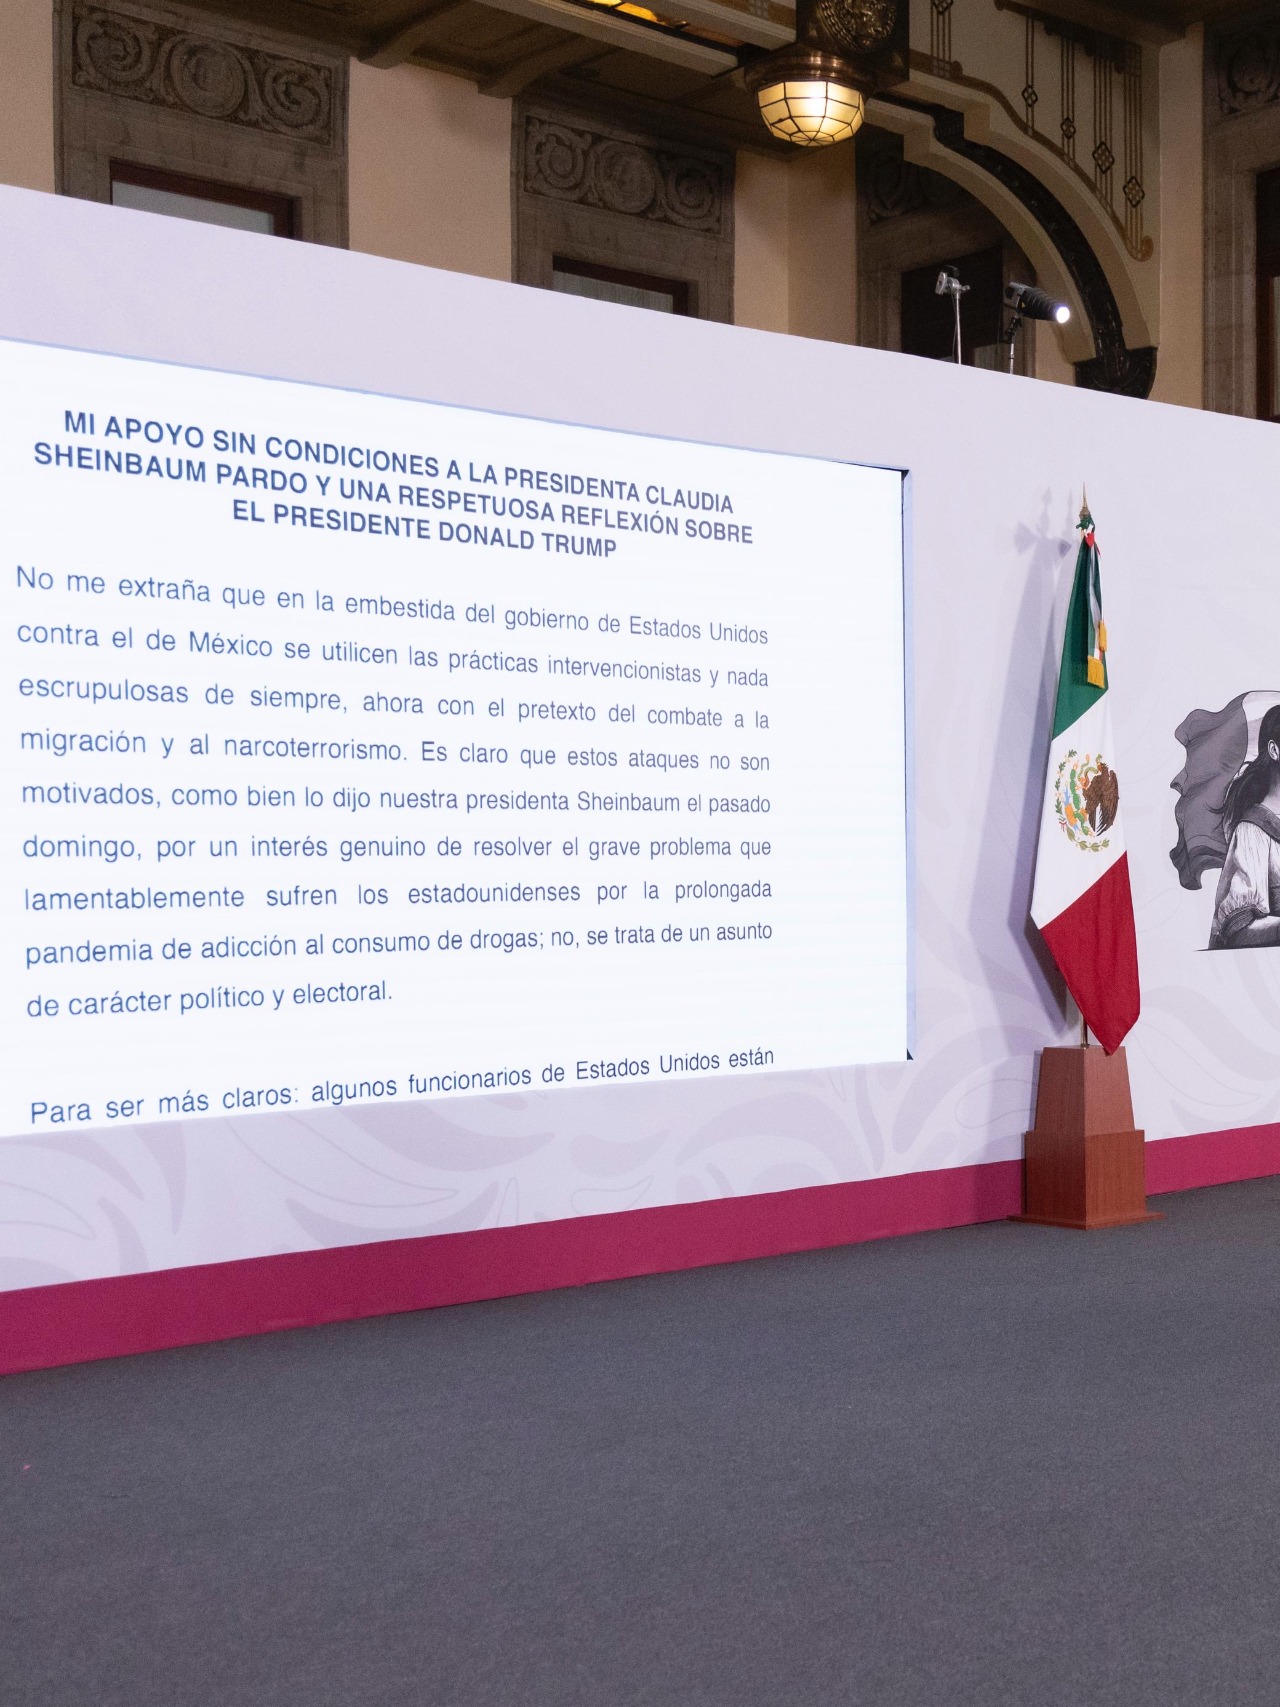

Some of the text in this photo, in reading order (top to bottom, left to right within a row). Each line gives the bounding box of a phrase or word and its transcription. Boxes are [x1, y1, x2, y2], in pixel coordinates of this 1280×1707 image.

[64, 409, 734, 514] MI APOYO SIN CONDICIONES A LA PRESIDENTA CLAUDIA
[33, 441, 753, 545] SHEINBAUM PARDO Y UNA RESPETUOSA REFLEXIÓN SOBRE
[232, 498, 617, 558] EL PRESIDENTE DONALD TRUMP
[16, 564, 769, 645] No me extraña que en la embestida del gobierno de Estados Unidos
[16, 623, 769, 689] contra el de México se utilicen las prácticas intervencionistas y nada
[18, 678, 770, 729] escrupulosas de siempre, ahora con el pretexto del combate a la
[20, 727, 770, 773] migración y al narcoterrorismo. Es claro que estos ataques no son
[22, 782, 771, 817] motivados, como bien lo dijo nuestra presidenta Sheinbaum el pasado
[22, 834, 772, 864] domingo, por un interés genuino de resolver el grave problema que
[24, 879, 773, 912] lamentablemente sufren los estadounidenses por la prolongada
[25, 921, 773, 971] pandemia de adicción al consumo de drogas; no, se trata de un asunto
[26, 979, 392, 1018] de carácter político y electoral.
[30, 1046, 774, 1125] Para ser más claros: algunos funcionarios de Estados Unidos están
